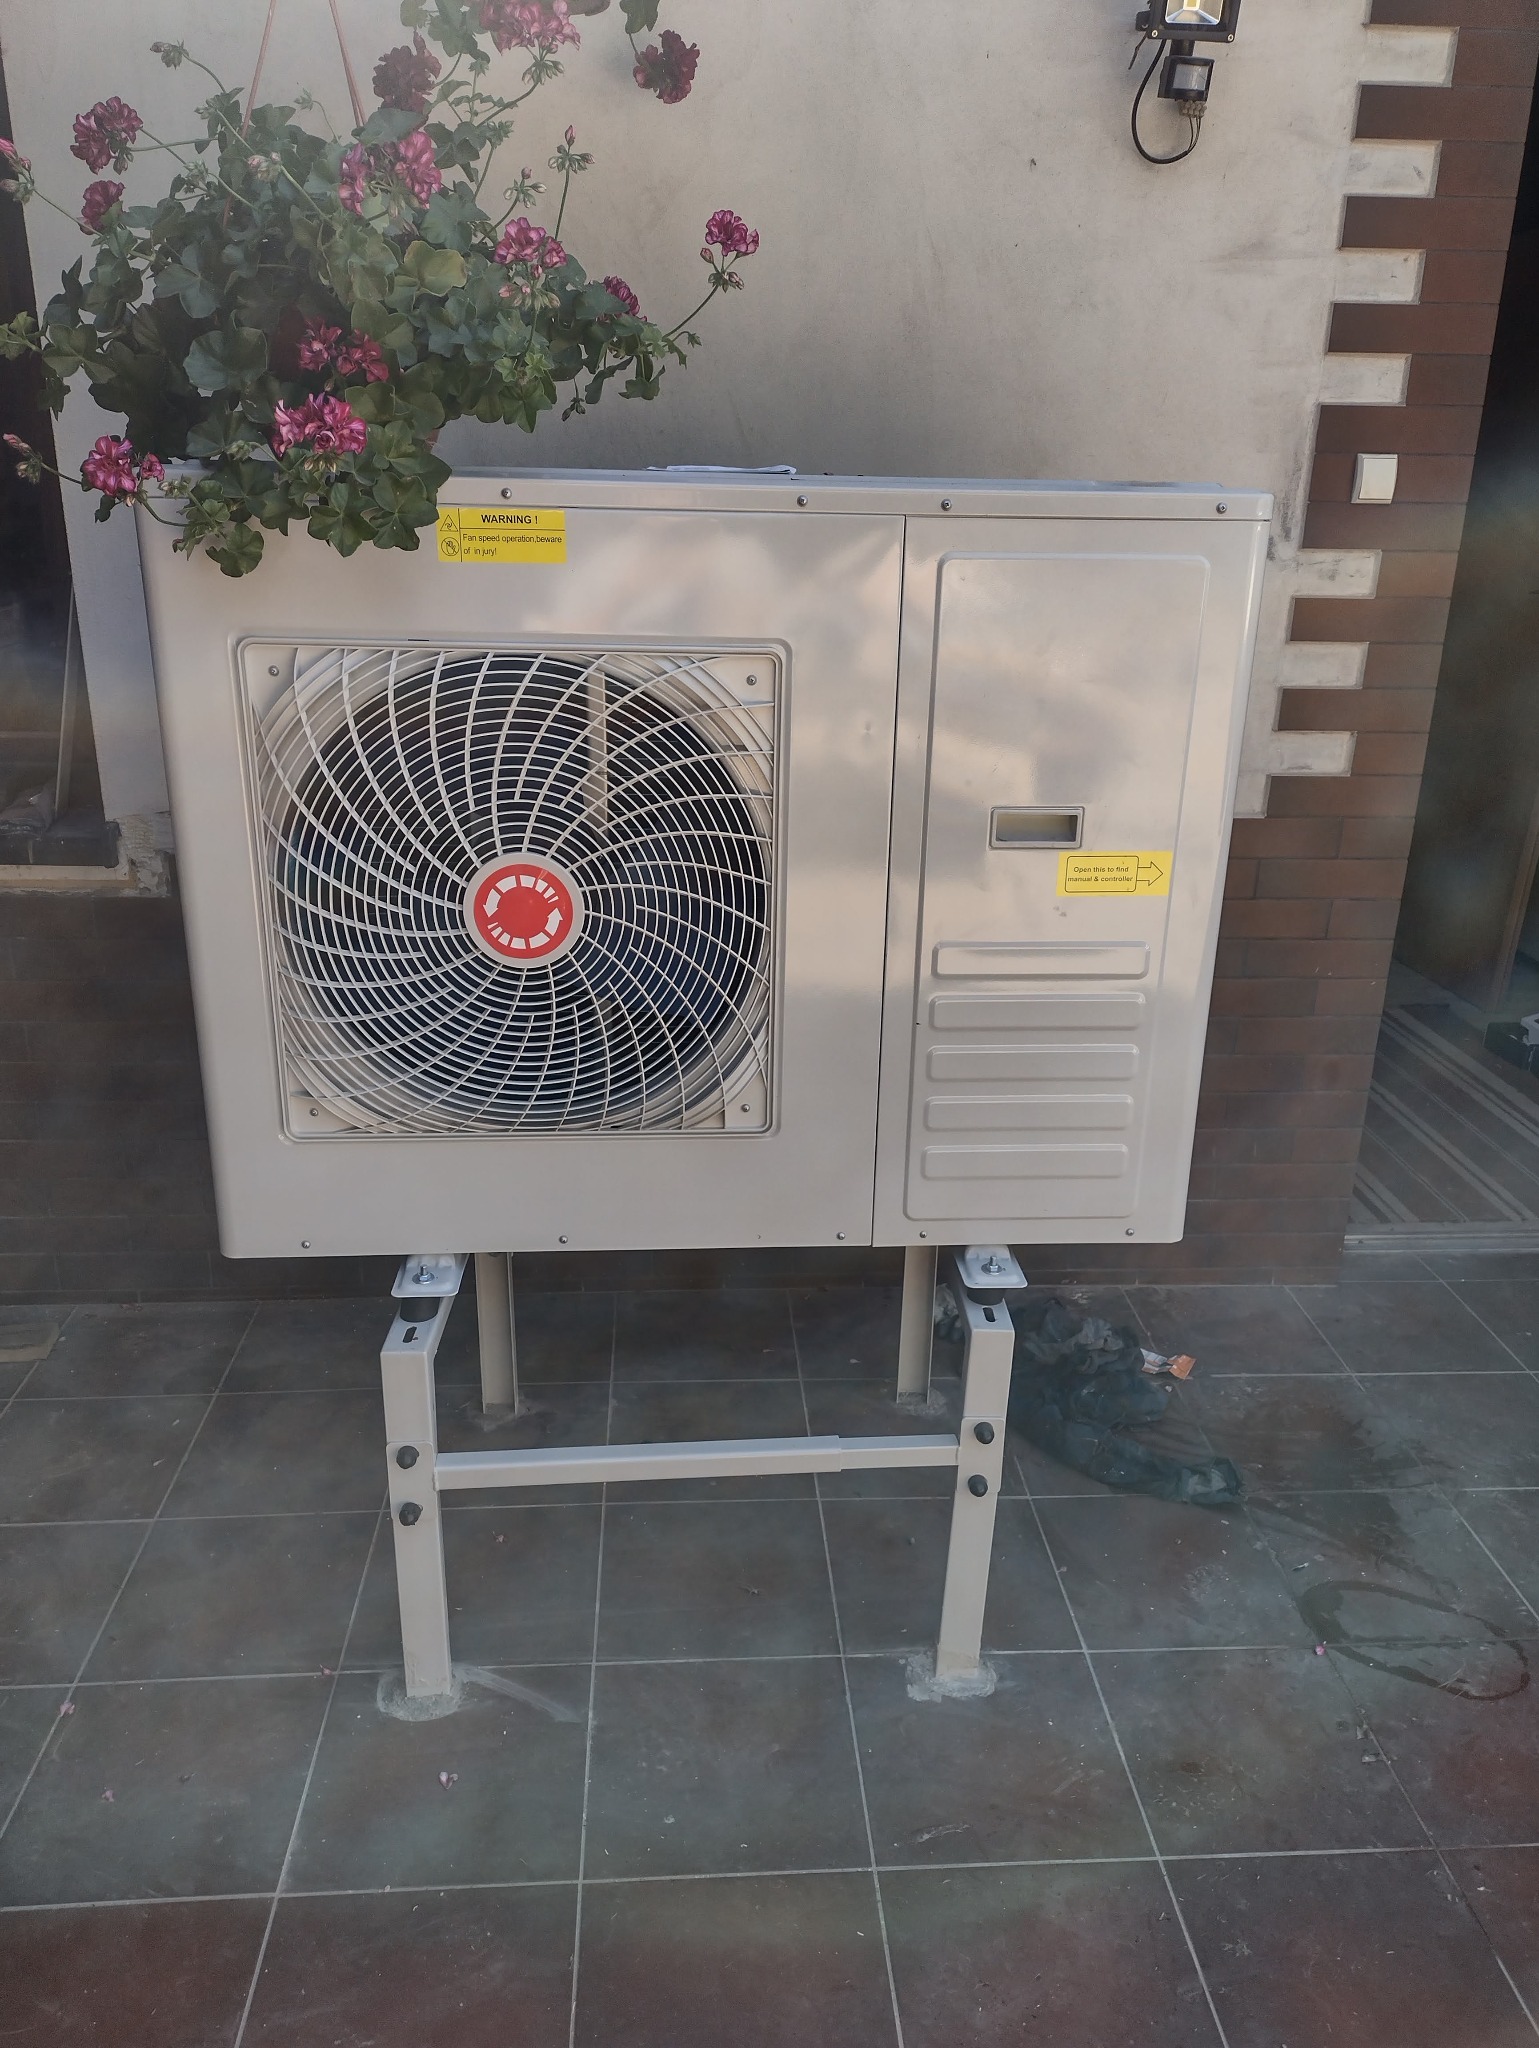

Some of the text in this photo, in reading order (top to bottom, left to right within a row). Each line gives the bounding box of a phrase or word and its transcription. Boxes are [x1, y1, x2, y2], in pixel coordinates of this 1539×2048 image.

[481, 514, 538, 524] WARNING !
[462, 533, 477, 542] Fan
[478, 534, 500, 543] speed
[463, 546, 471, 555] of
[1073, 866, 1092, 874] Open
